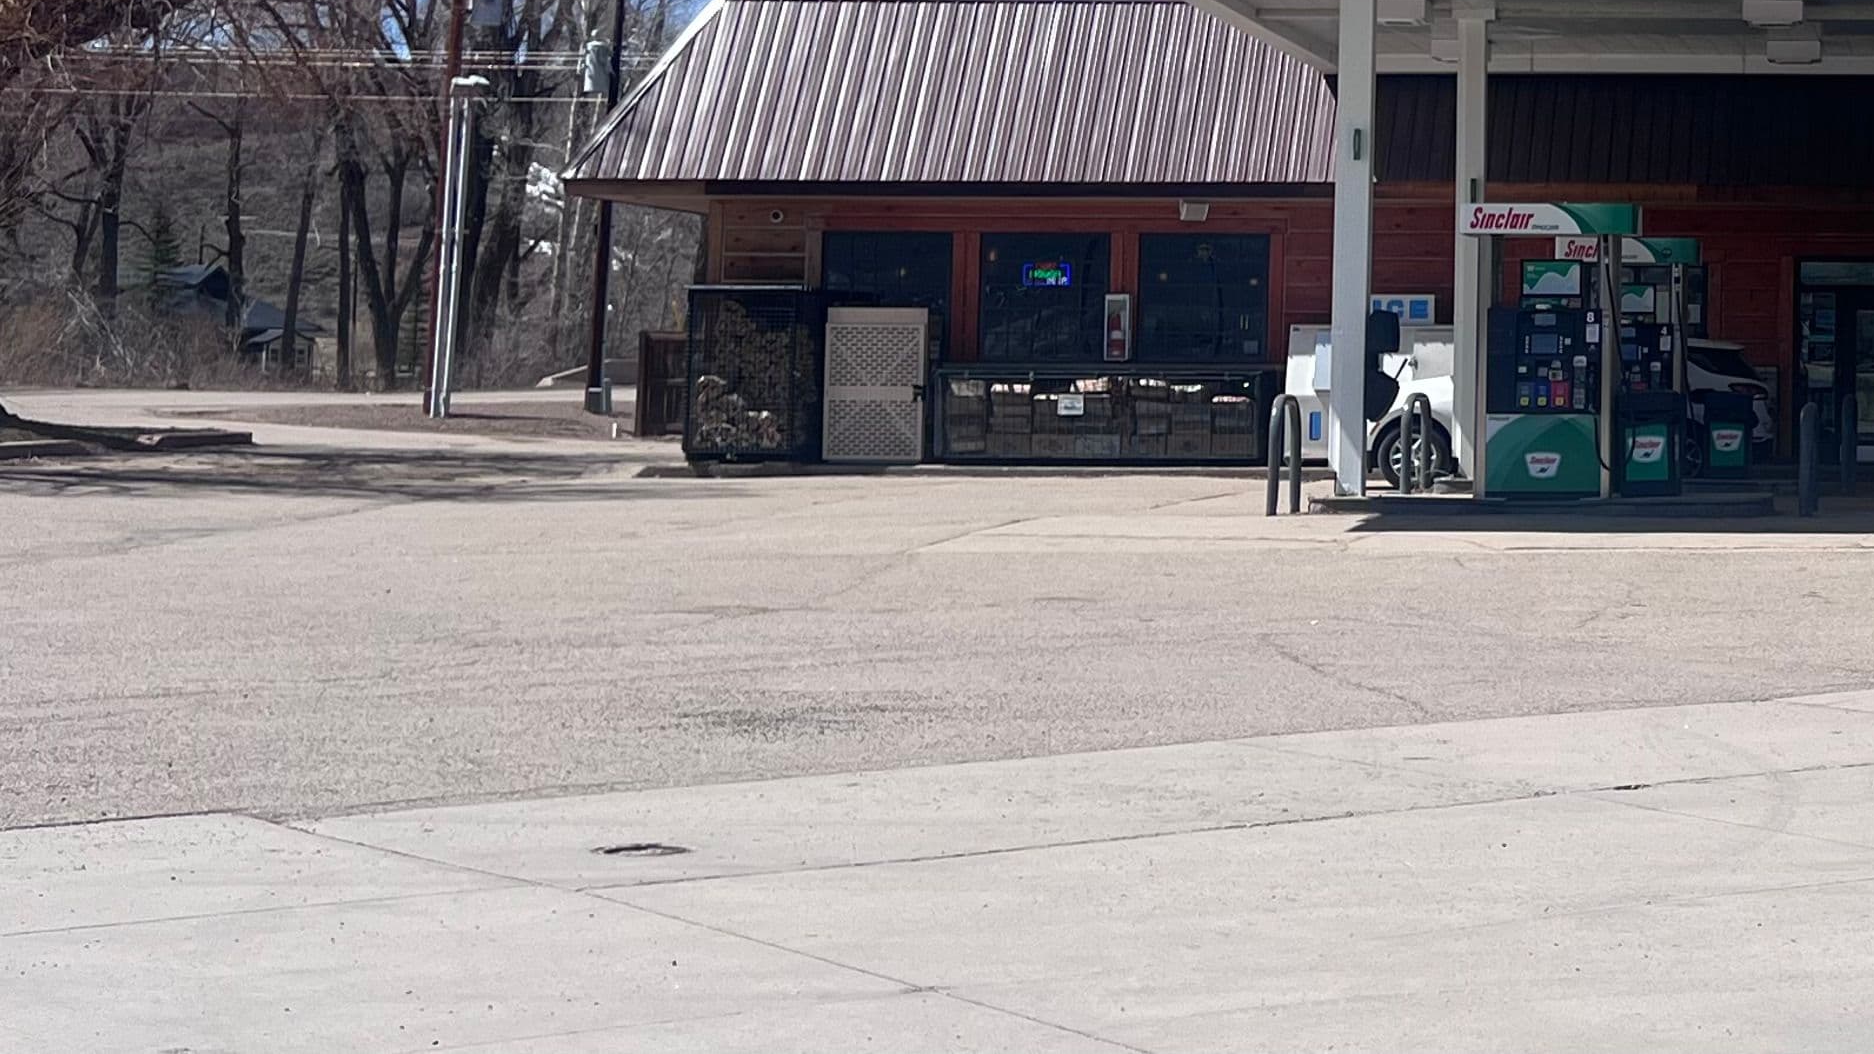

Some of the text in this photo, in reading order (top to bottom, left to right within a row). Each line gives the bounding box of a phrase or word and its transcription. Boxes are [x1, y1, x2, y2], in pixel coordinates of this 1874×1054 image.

[1470, 207, 1535, 230] Sinclair
[1564, 239, 1598, 258] Sincl
[1373, 299, 1429, 319] ICE
[1586, 311, 1595, 323] 8
[1660, 325, 1668, 335] 4
